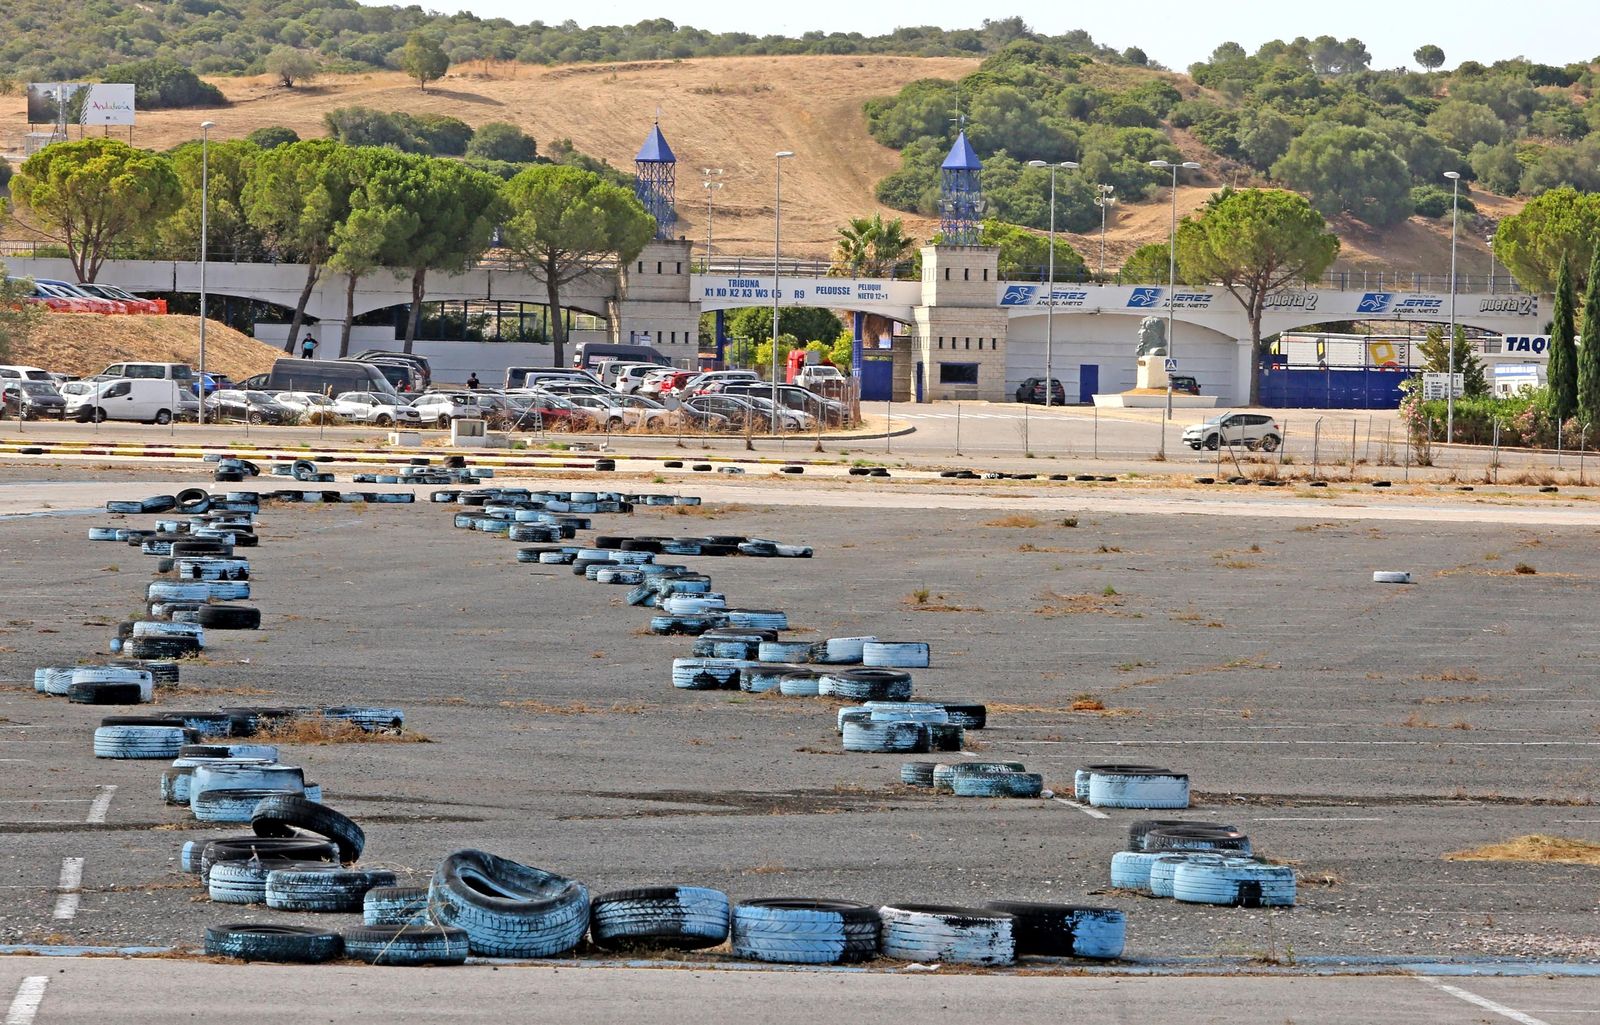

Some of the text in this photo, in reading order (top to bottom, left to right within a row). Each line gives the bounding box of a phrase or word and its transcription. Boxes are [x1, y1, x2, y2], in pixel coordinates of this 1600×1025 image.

[728, 279, 760, 288] TRIBUNA
[705, 288, 713, 296] X1
[730, 288, 739, 297] X2
[742, 289, 752, 298] X3
[756, 289, 768, 298] W3
[794, 290, 805, 299] R9
[816, 286, 850, 295] PELOUSSE
[1040, 291, 1087, 300] JEREZ
[1165, 294, 1213, 302] JEREZ
[1305, 292, 1318, 310] 2
[1480, 297, 1532, 315] puerta 2
